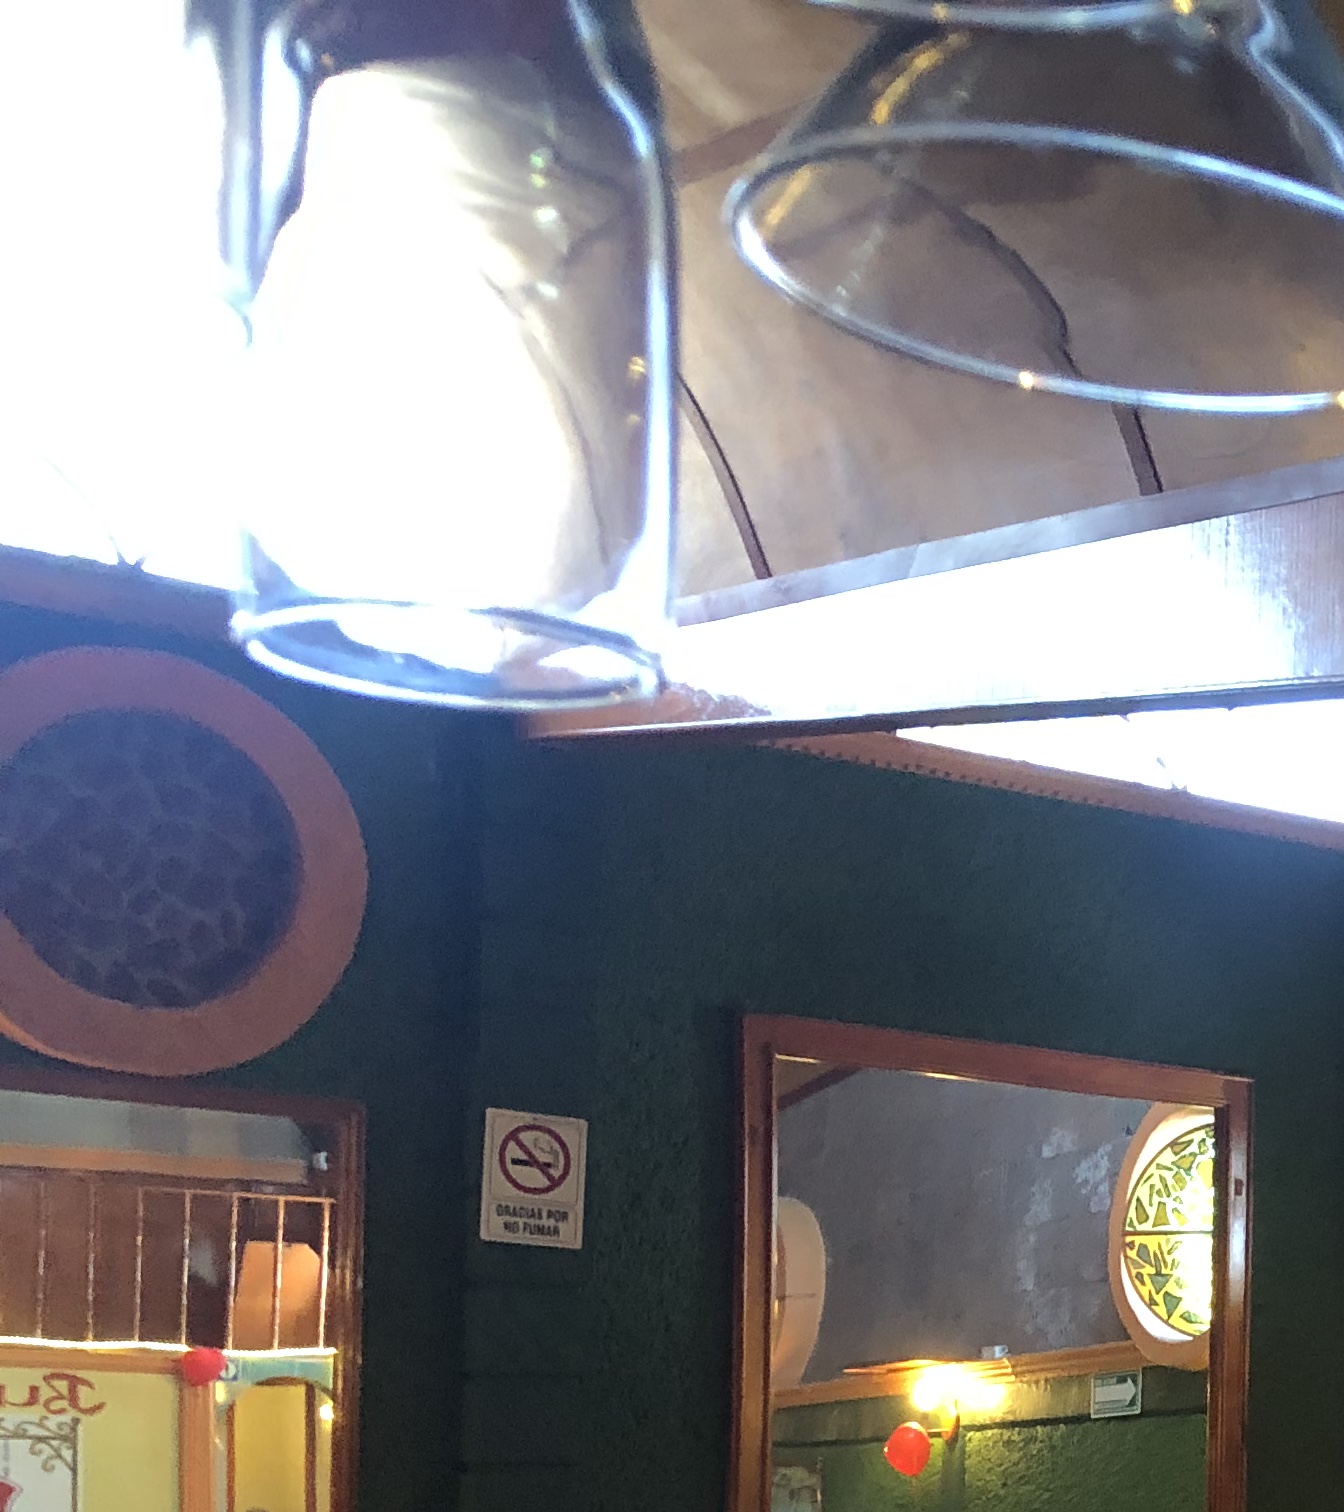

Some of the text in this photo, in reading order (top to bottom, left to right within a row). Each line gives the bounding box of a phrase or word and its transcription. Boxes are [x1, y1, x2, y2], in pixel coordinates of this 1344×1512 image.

[496, 1204, 569, 1223] GRACIAS POR
[503, 1220, 561, 1238] NO FUMAR
